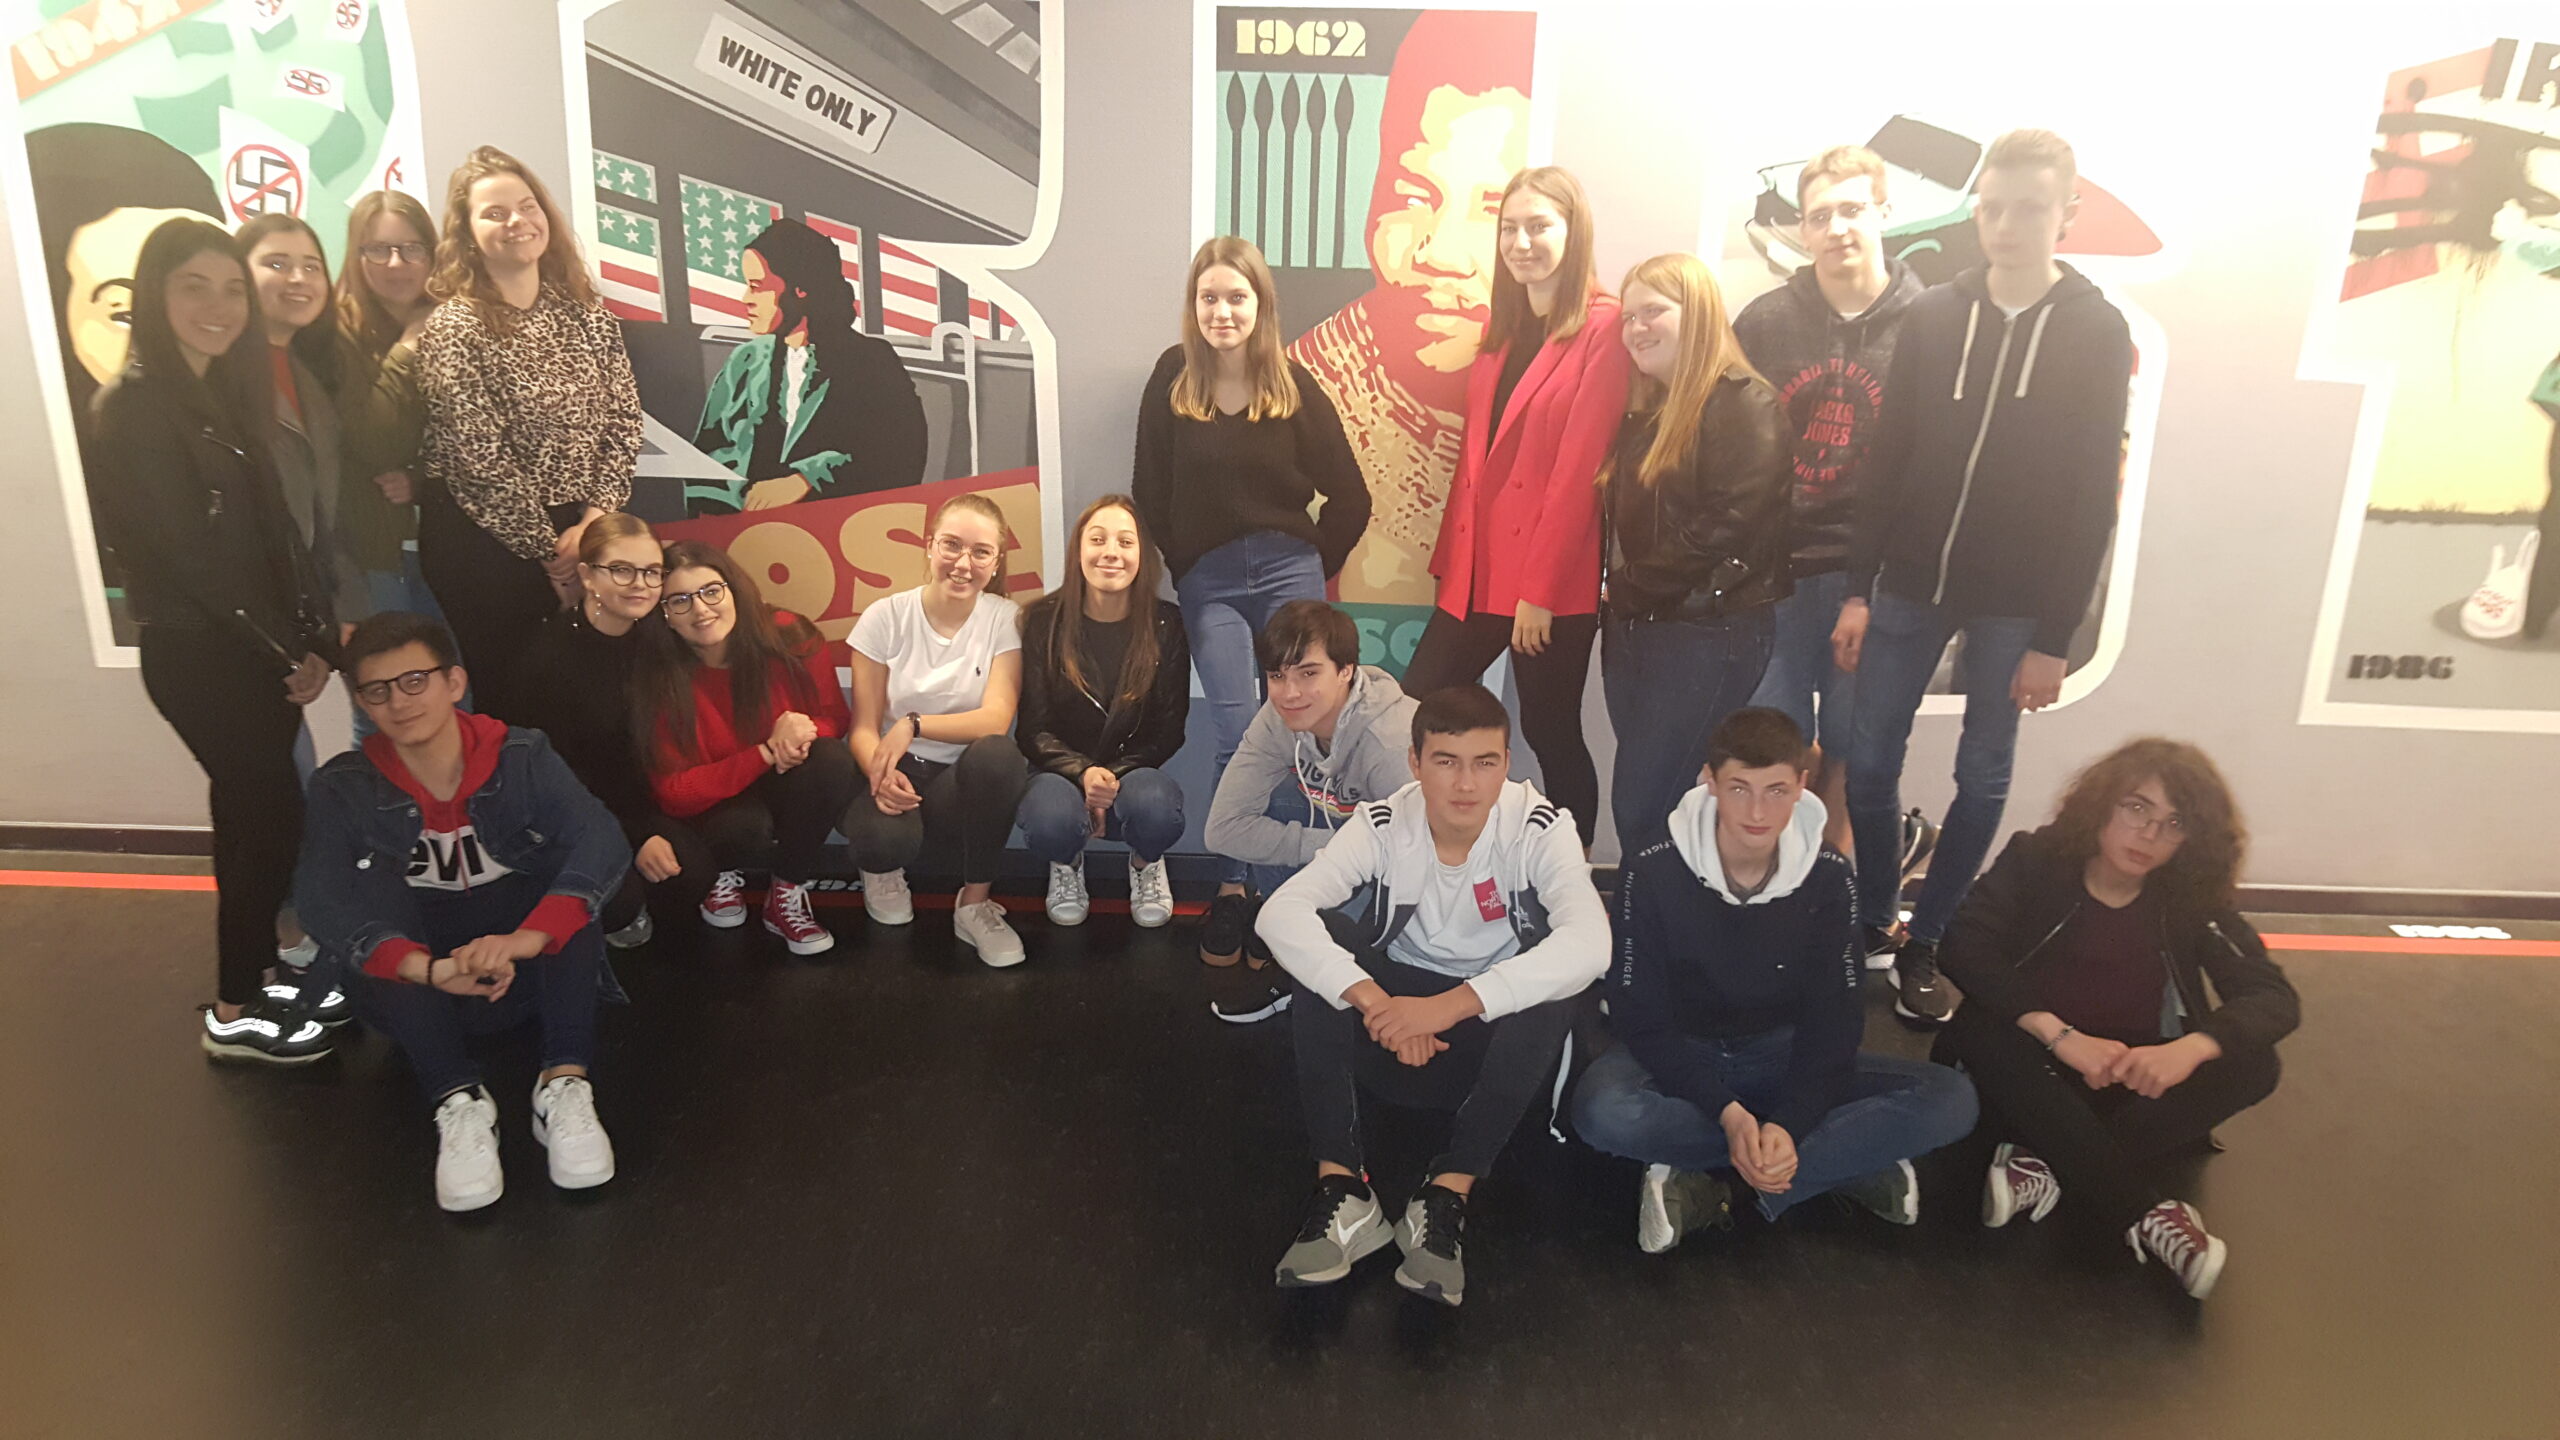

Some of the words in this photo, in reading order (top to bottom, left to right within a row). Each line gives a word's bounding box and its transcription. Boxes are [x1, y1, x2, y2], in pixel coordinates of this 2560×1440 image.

[1236, 19, 1366, 57] 1962
[719, 36, 802, 100] WHITE
[805, 84, 877, 137] ONLY
[2346, 654, 2456, 679] 1986
[1622, 937, 1633, 987] HILFIGER
